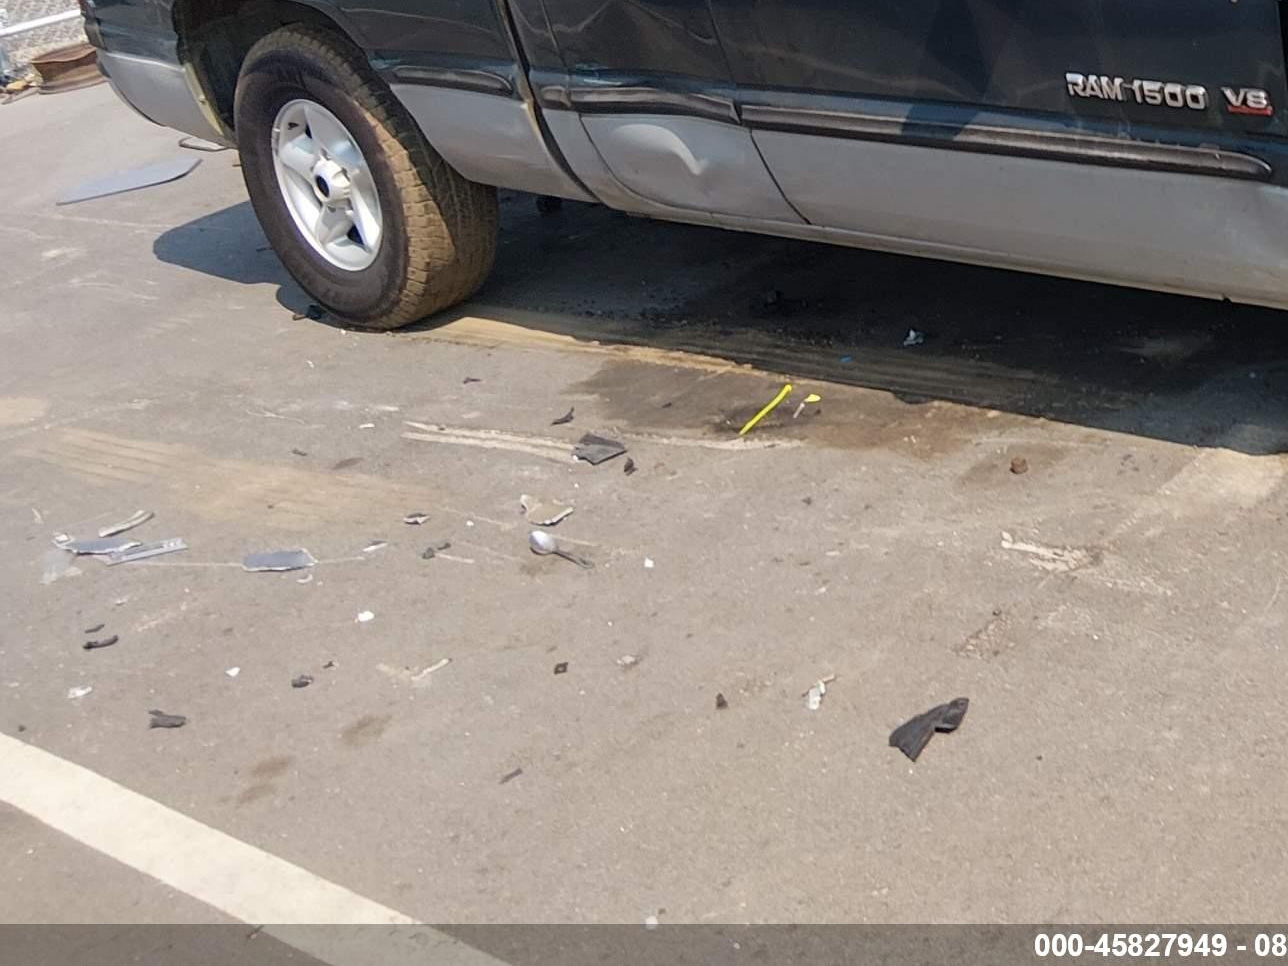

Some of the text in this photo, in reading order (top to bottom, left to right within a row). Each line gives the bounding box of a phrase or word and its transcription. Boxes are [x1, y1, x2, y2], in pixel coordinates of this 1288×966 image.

[1065, 72, 1270, 110] RAM 1500 V8
